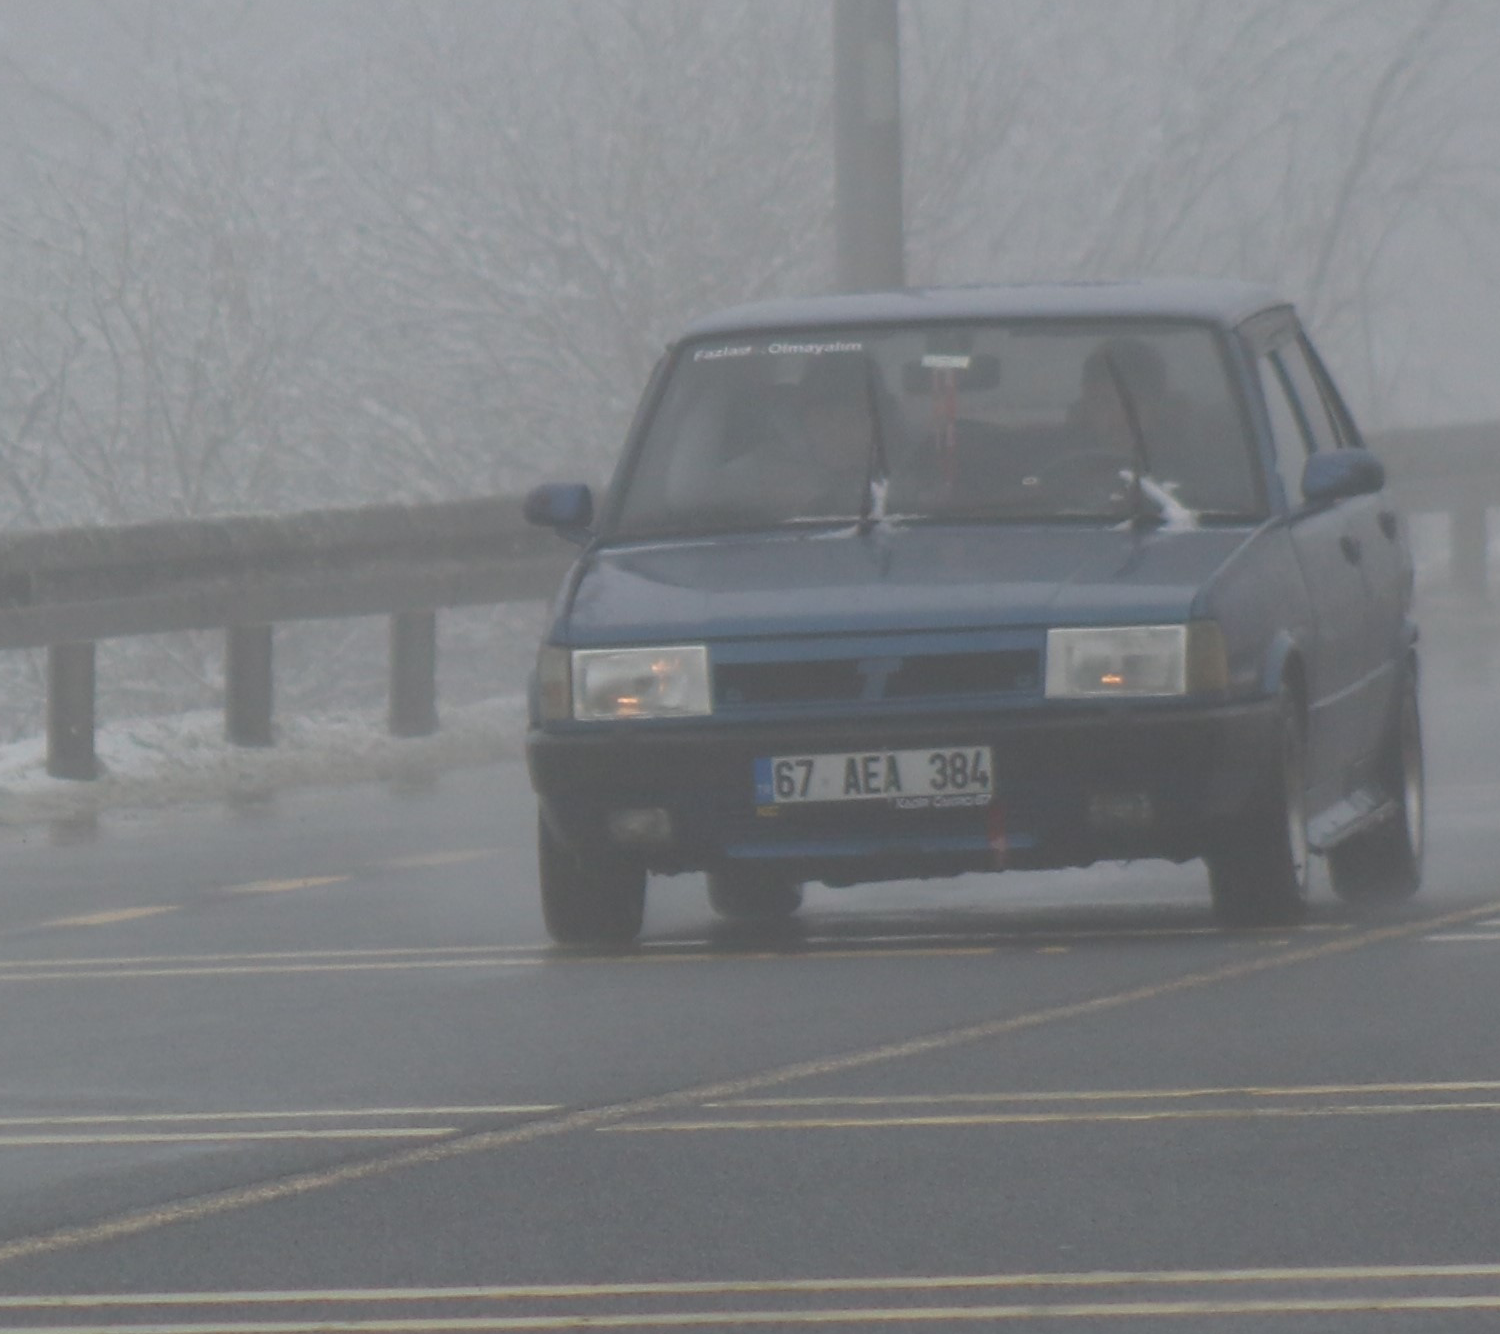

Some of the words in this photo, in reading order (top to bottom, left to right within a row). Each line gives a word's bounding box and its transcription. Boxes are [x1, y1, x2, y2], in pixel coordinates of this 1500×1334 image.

[774, 759, 815, 799] 67
[843, 754, 902, 795] AEA
[928, 749, 990, 791] 384
